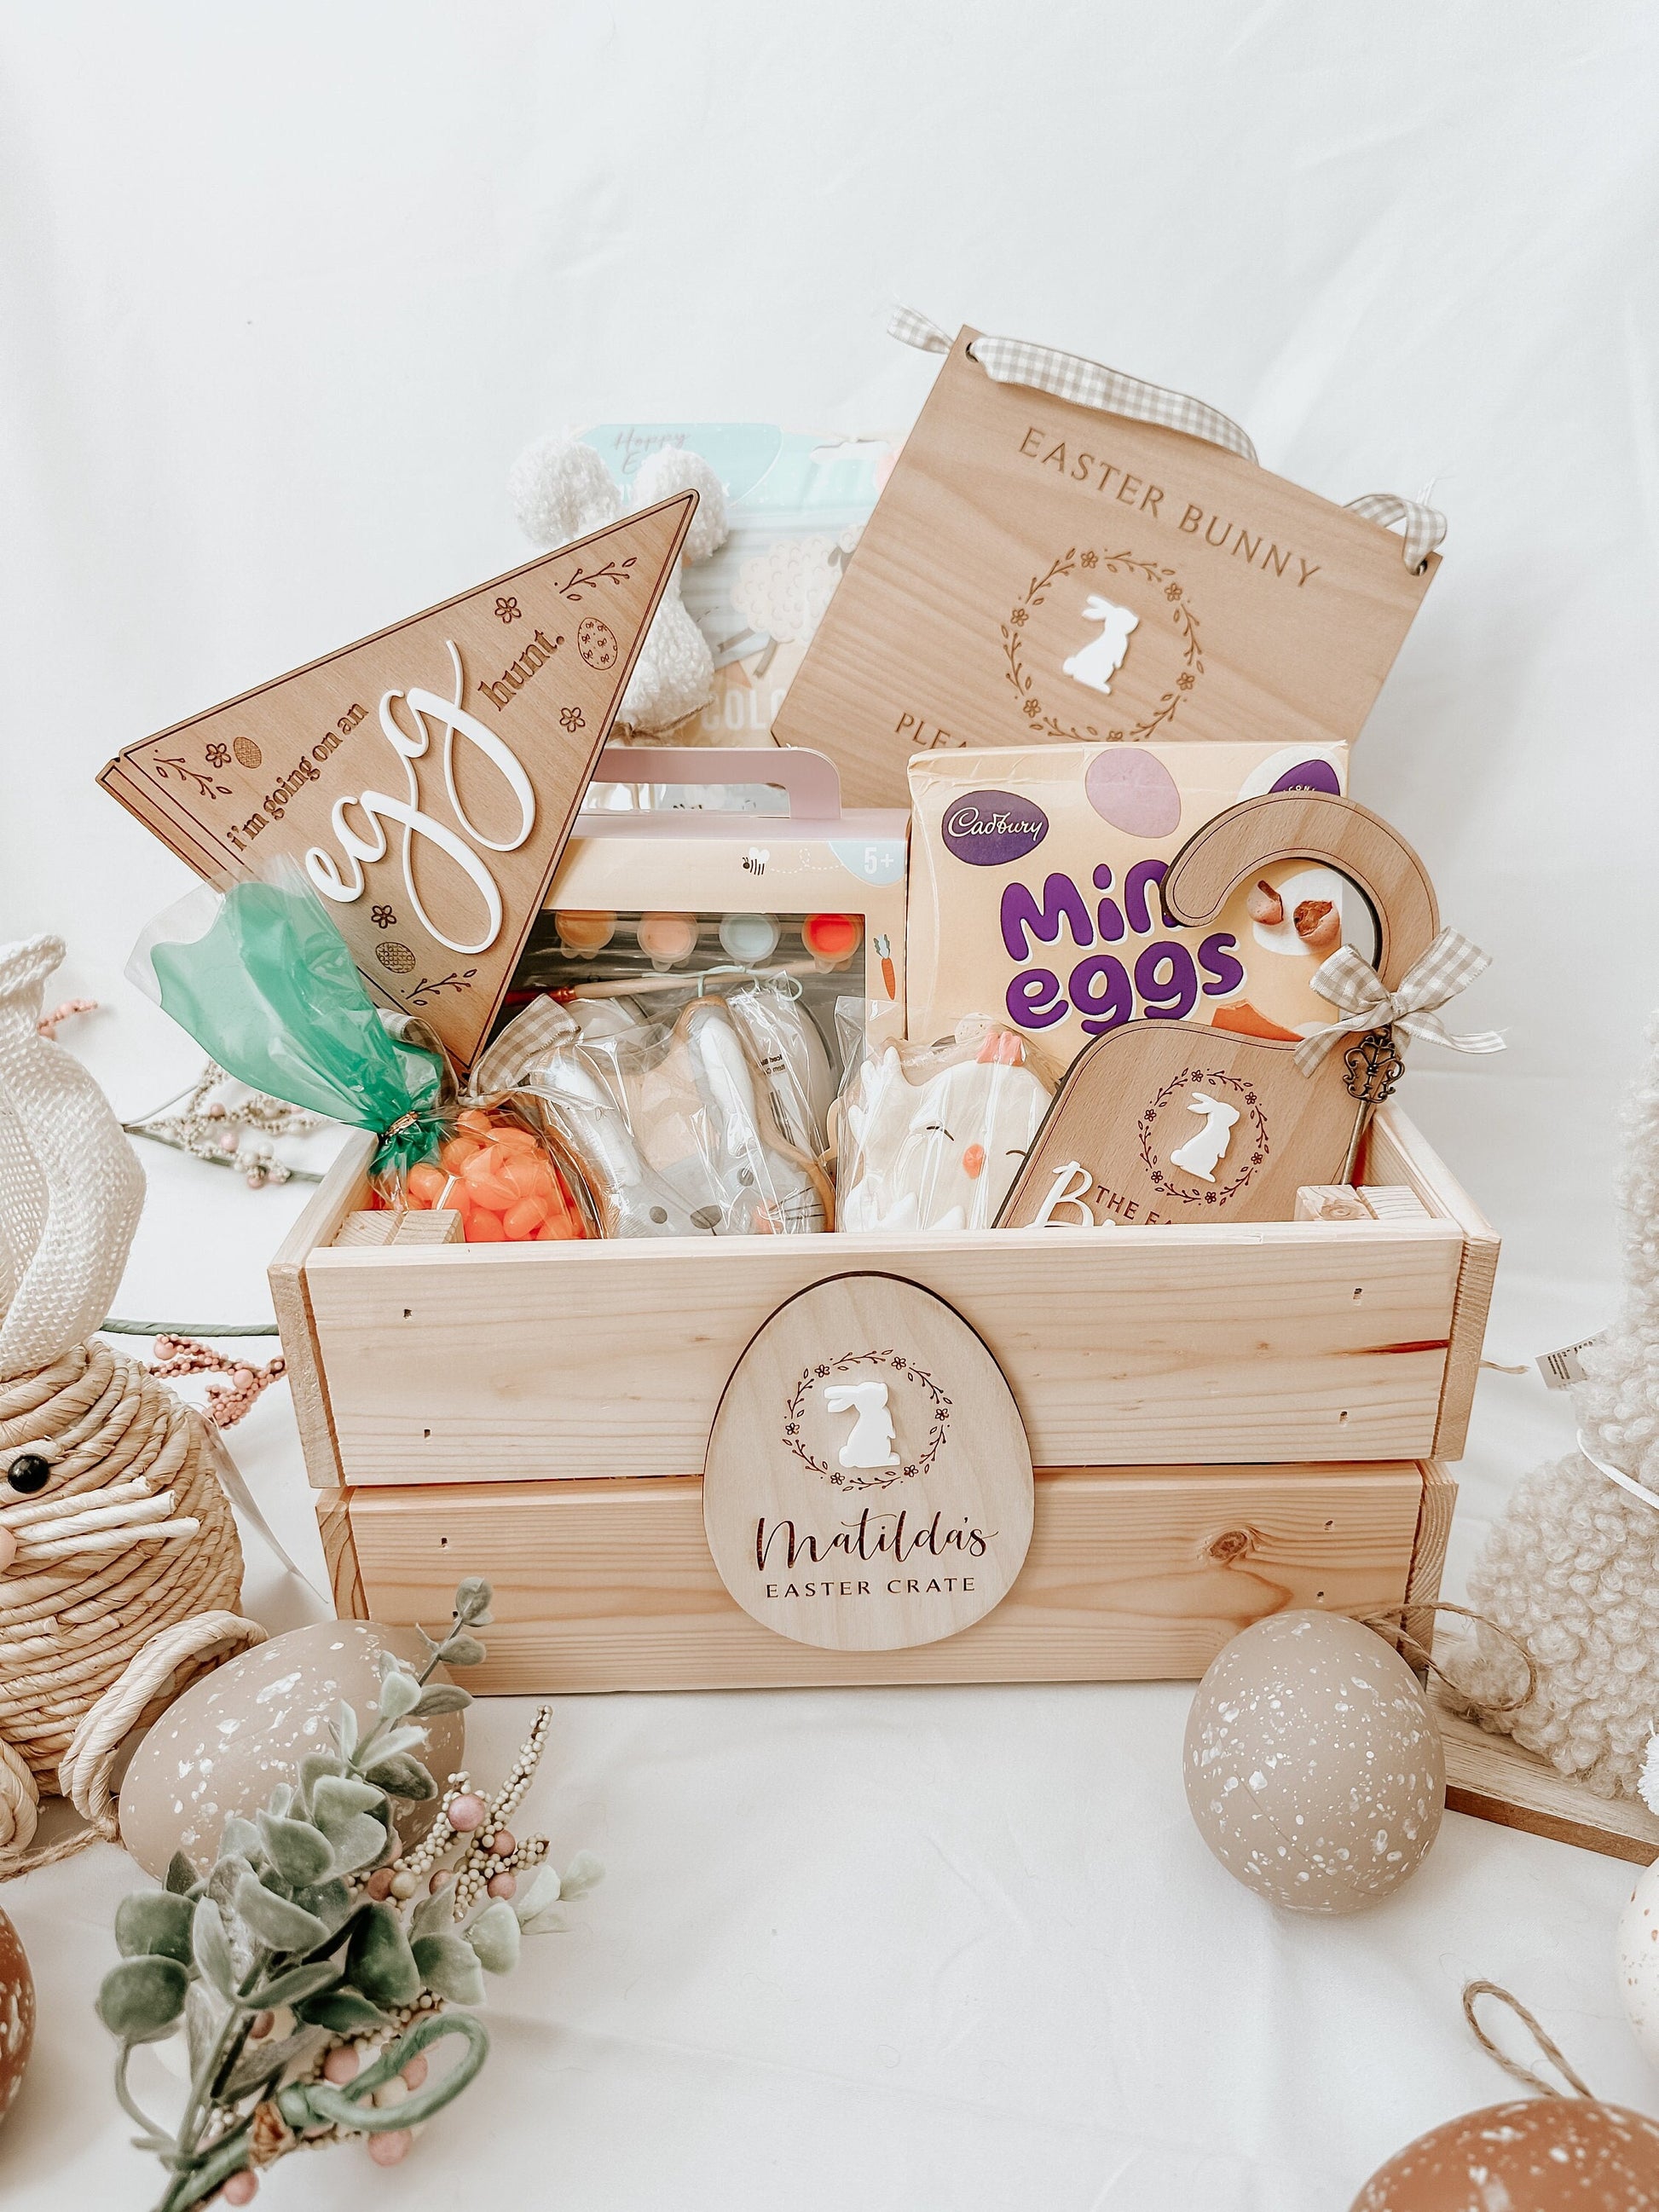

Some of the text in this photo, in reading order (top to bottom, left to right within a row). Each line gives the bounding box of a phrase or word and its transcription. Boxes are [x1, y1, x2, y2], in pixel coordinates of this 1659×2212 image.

[1019, 427, 1321, 588] EASTER BUNNY
[477, 629, 565, 712] hunt.
[894, 713, 967, 749] PLE
[226, 703, 369, 852] i'm going on an
[305, 640, 536, 955] egg
[948, 806, 1044, 841] Cadbury
[1000, 859, 1180, 963] Min
[1006, 933, 1246, 1035] eggs
[1095, 1185, 1140, 1220] THE
[756, 1508, 999, 1571] Matilda's
[766, 1577, 976, 1598] EASTER CRATE
